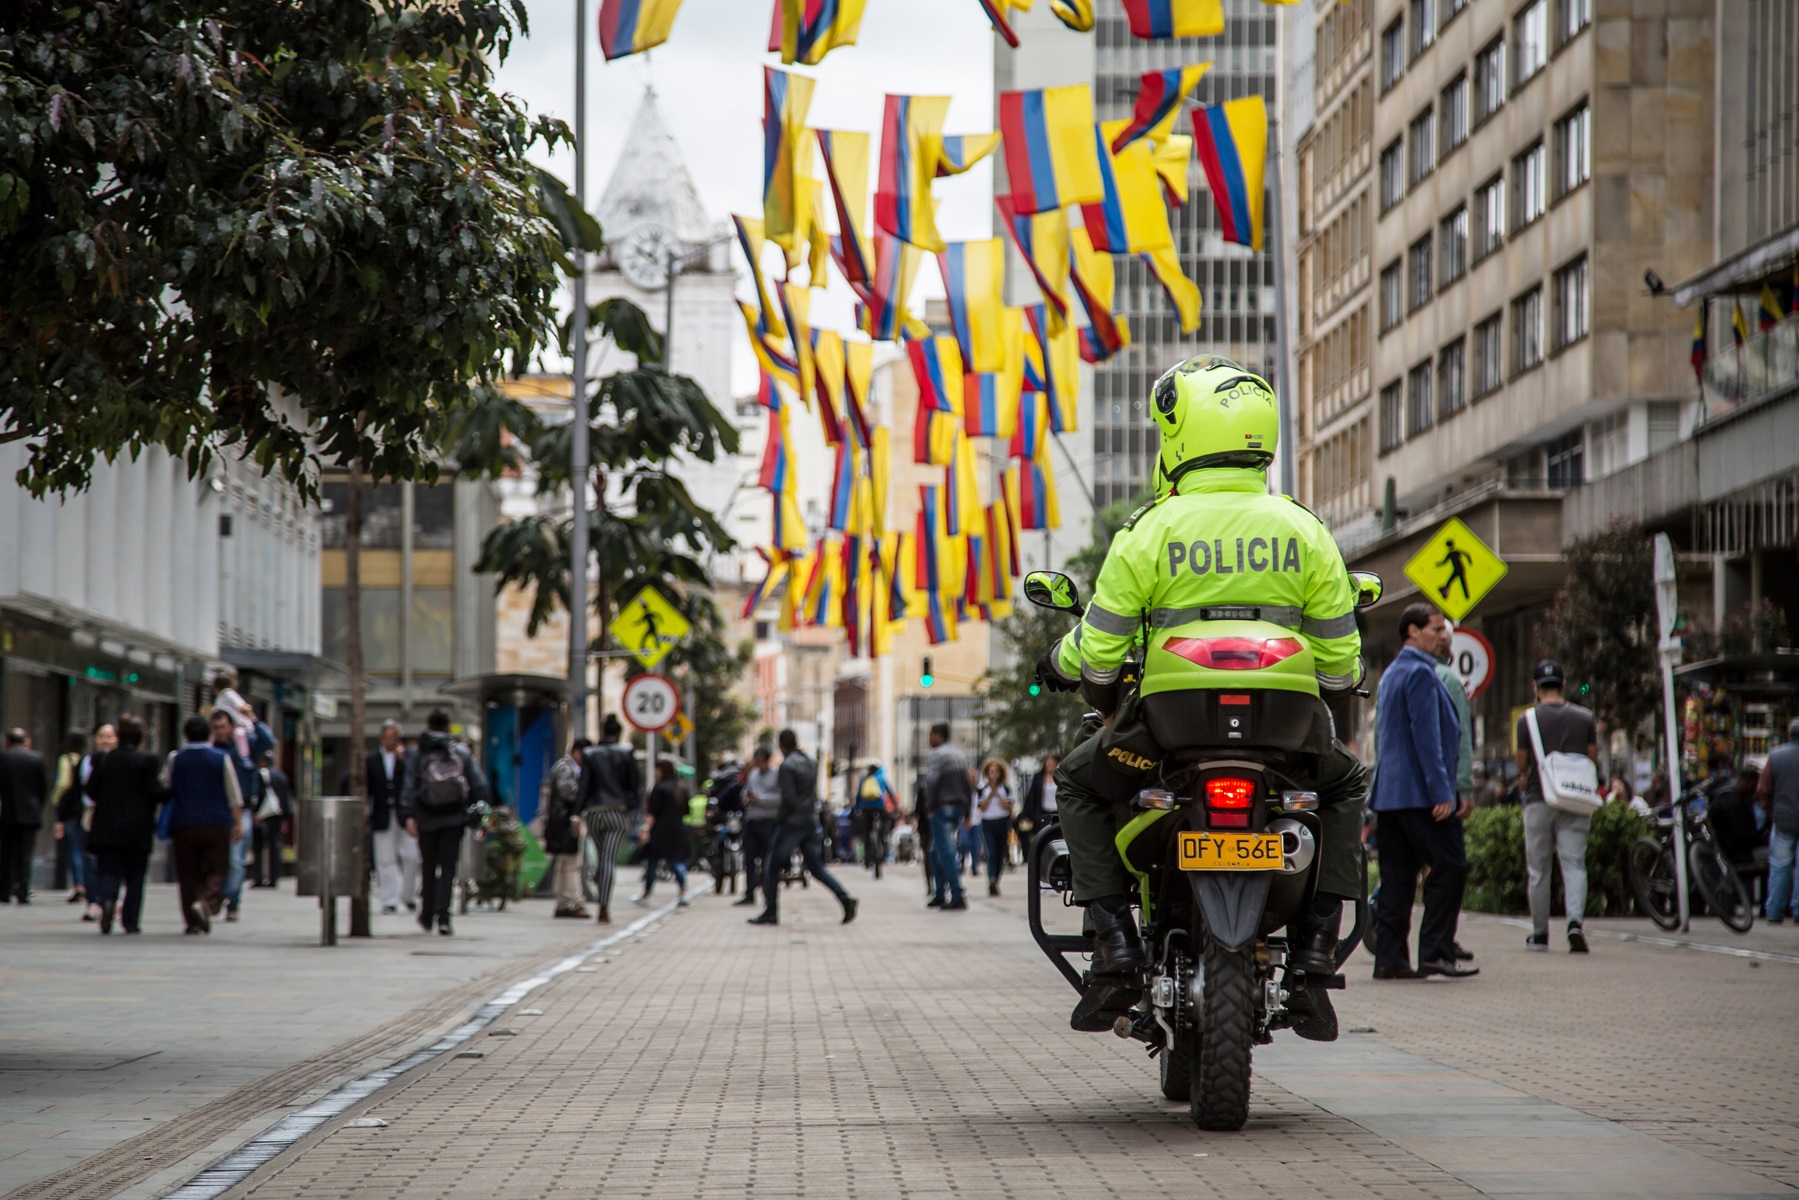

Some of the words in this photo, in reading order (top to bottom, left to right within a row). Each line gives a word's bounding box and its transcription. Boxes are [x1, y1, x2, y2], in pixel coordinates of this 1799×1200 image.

[1219, 385, 1273, 409] POLICIA
[1167, 537, 1302, 577] POLICIA
[637, 691, 665, 715] 20
[1183, 838, 1225, 859] OFY
[1236, 839, 1280, 859] 56E
